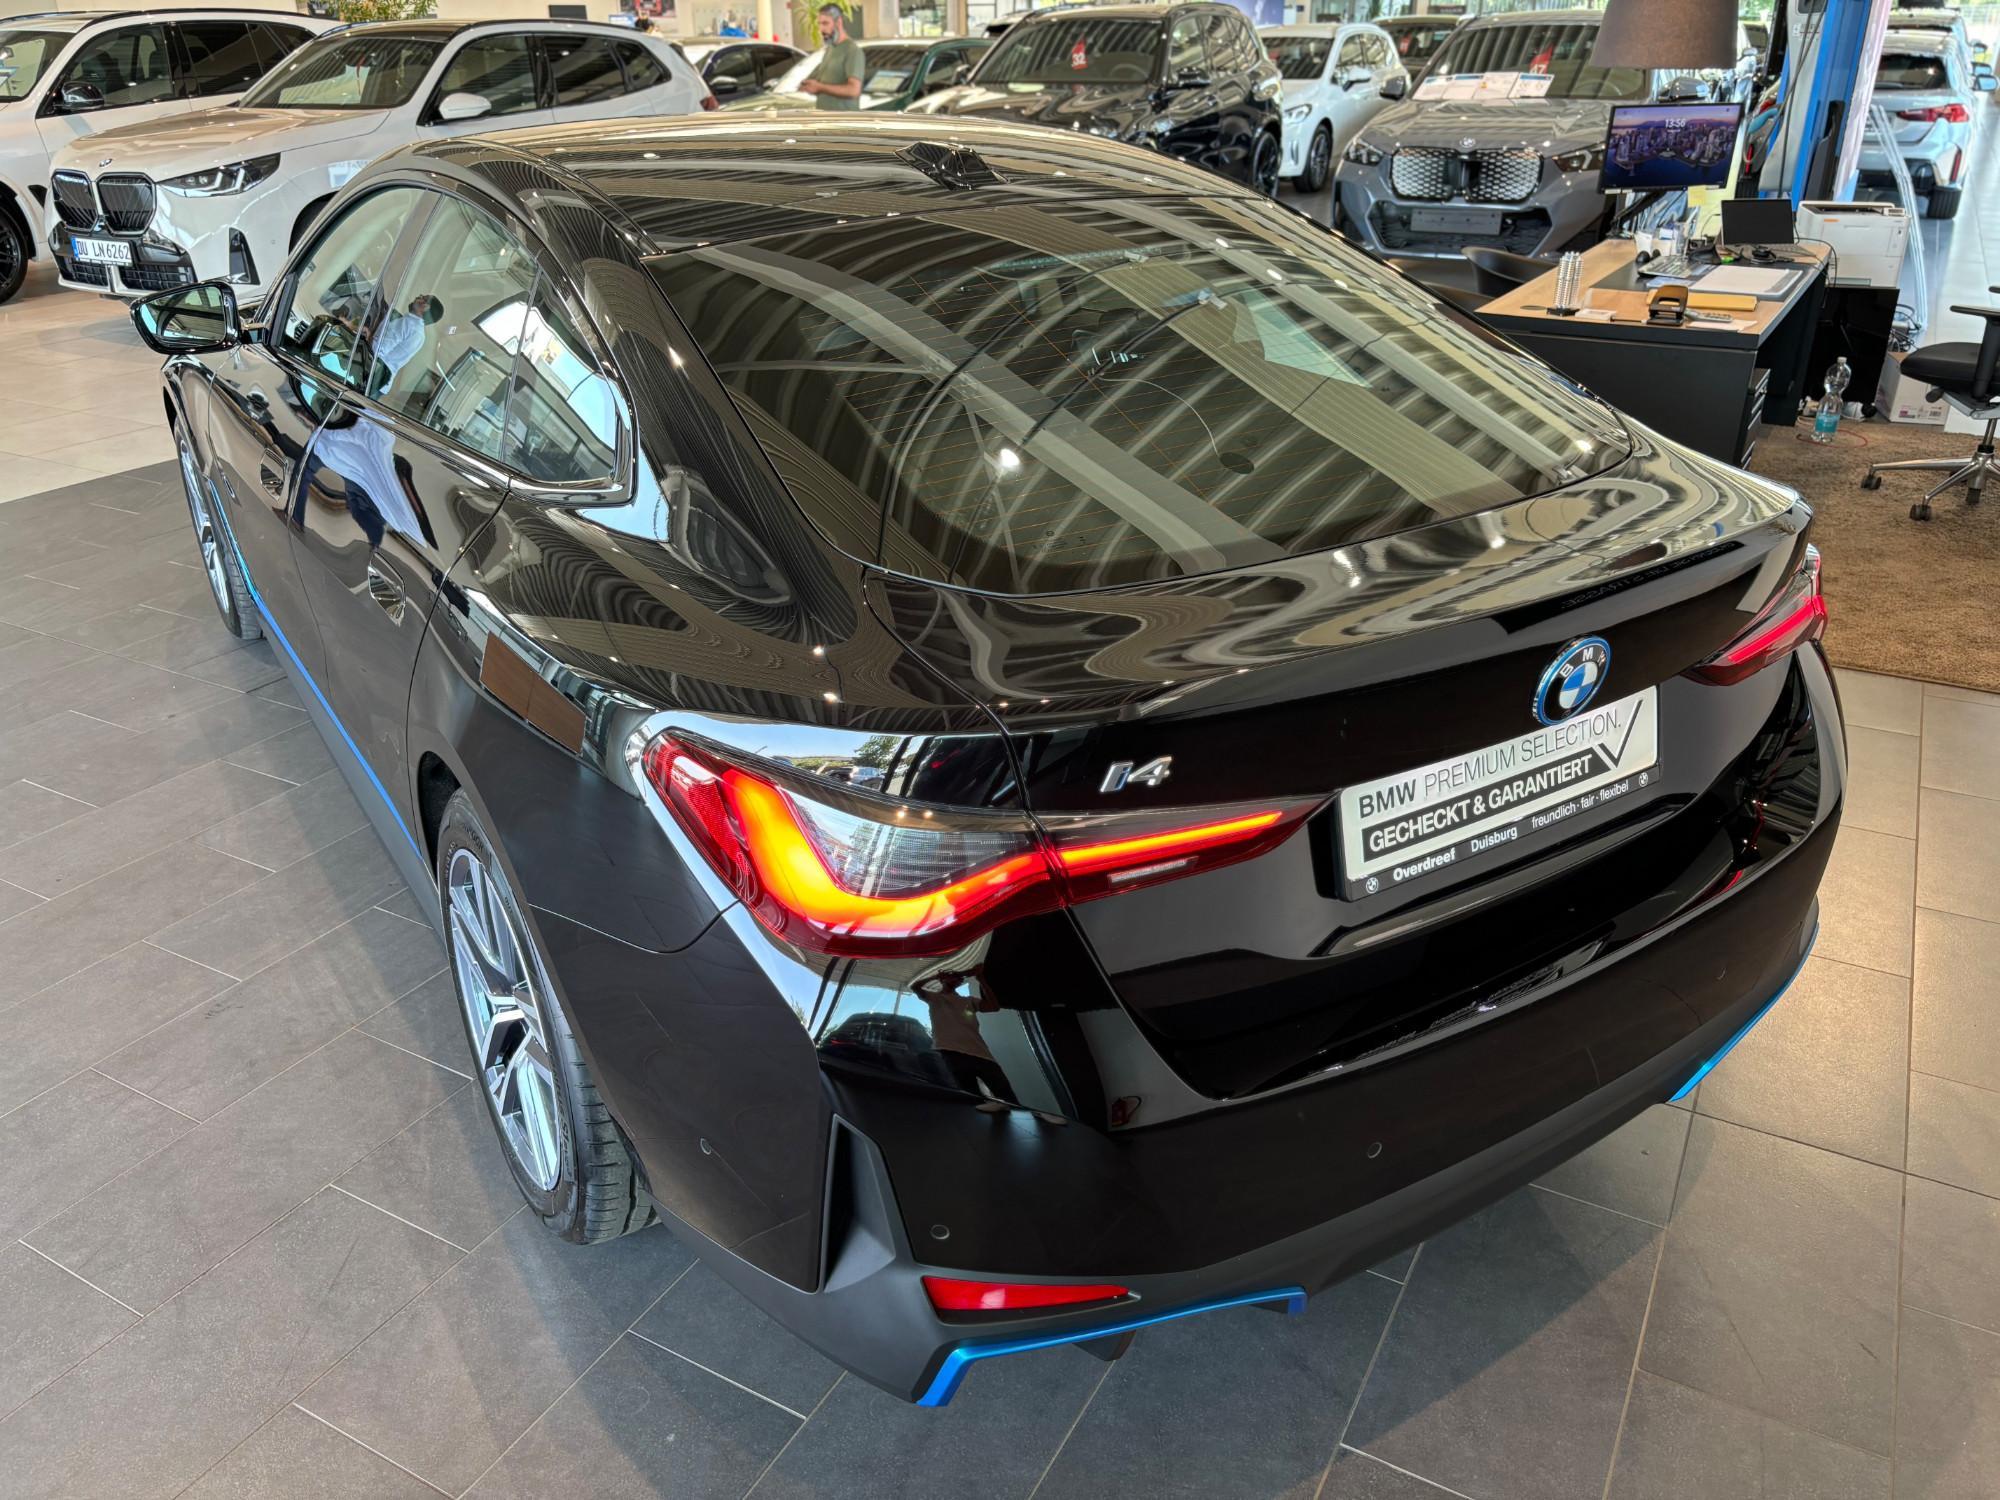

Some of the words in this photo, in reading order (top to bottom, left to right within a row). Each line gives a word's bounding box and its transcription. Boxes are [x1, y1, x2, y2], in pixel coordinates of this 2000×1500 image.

[1100, 756, 1172, 792] i4
[1360, 779, 1416, 818] BMW
[1424, 745, 1516, 797] PREMIUM
[1521, 709, 1621, 762] SELECTION.
[1369, 798, 1471, 853] GECHECKT
[1473, 795, 1487, 815] &
[1489, 754, 1592, 808] GARANTIERT
[1393, 848, 1456, 881] Overdreef
[1471, 826, 1518, 853] Duisburg
[1532, 803, 1576, 829] freundlich
[1581, 794, 1595, 809] fair
[1600, 779, 1629, 801] flexibel
